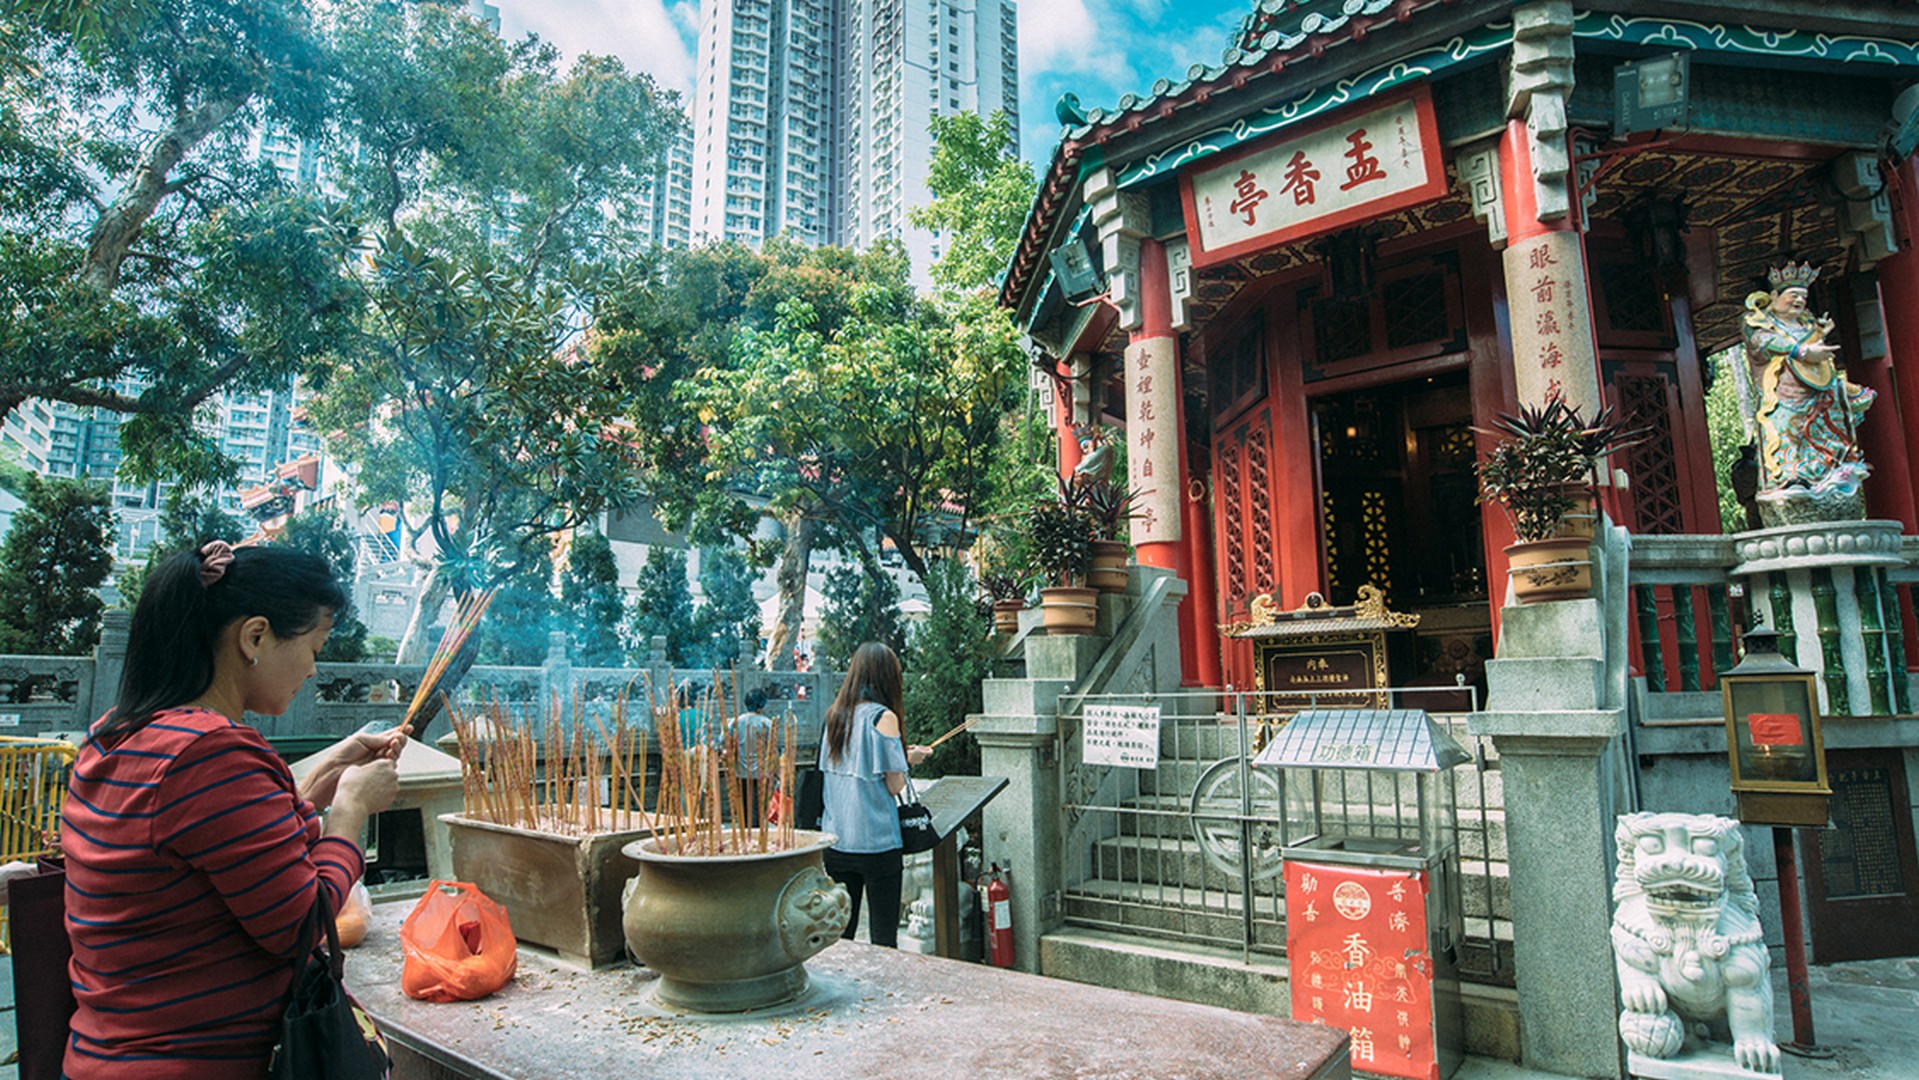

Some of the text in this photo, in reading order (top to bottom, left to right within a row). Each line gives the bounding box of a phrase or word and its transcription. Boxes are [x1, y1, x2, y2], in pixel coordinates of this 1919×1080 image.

[1529, 243, 1568, 419] 眼前瀛海成
[1318, 743, 1371, 762] 功德箱
[1386, 880, 1411, 933] 普濟
[1341, 931, 1375, 1064] 香油箱
